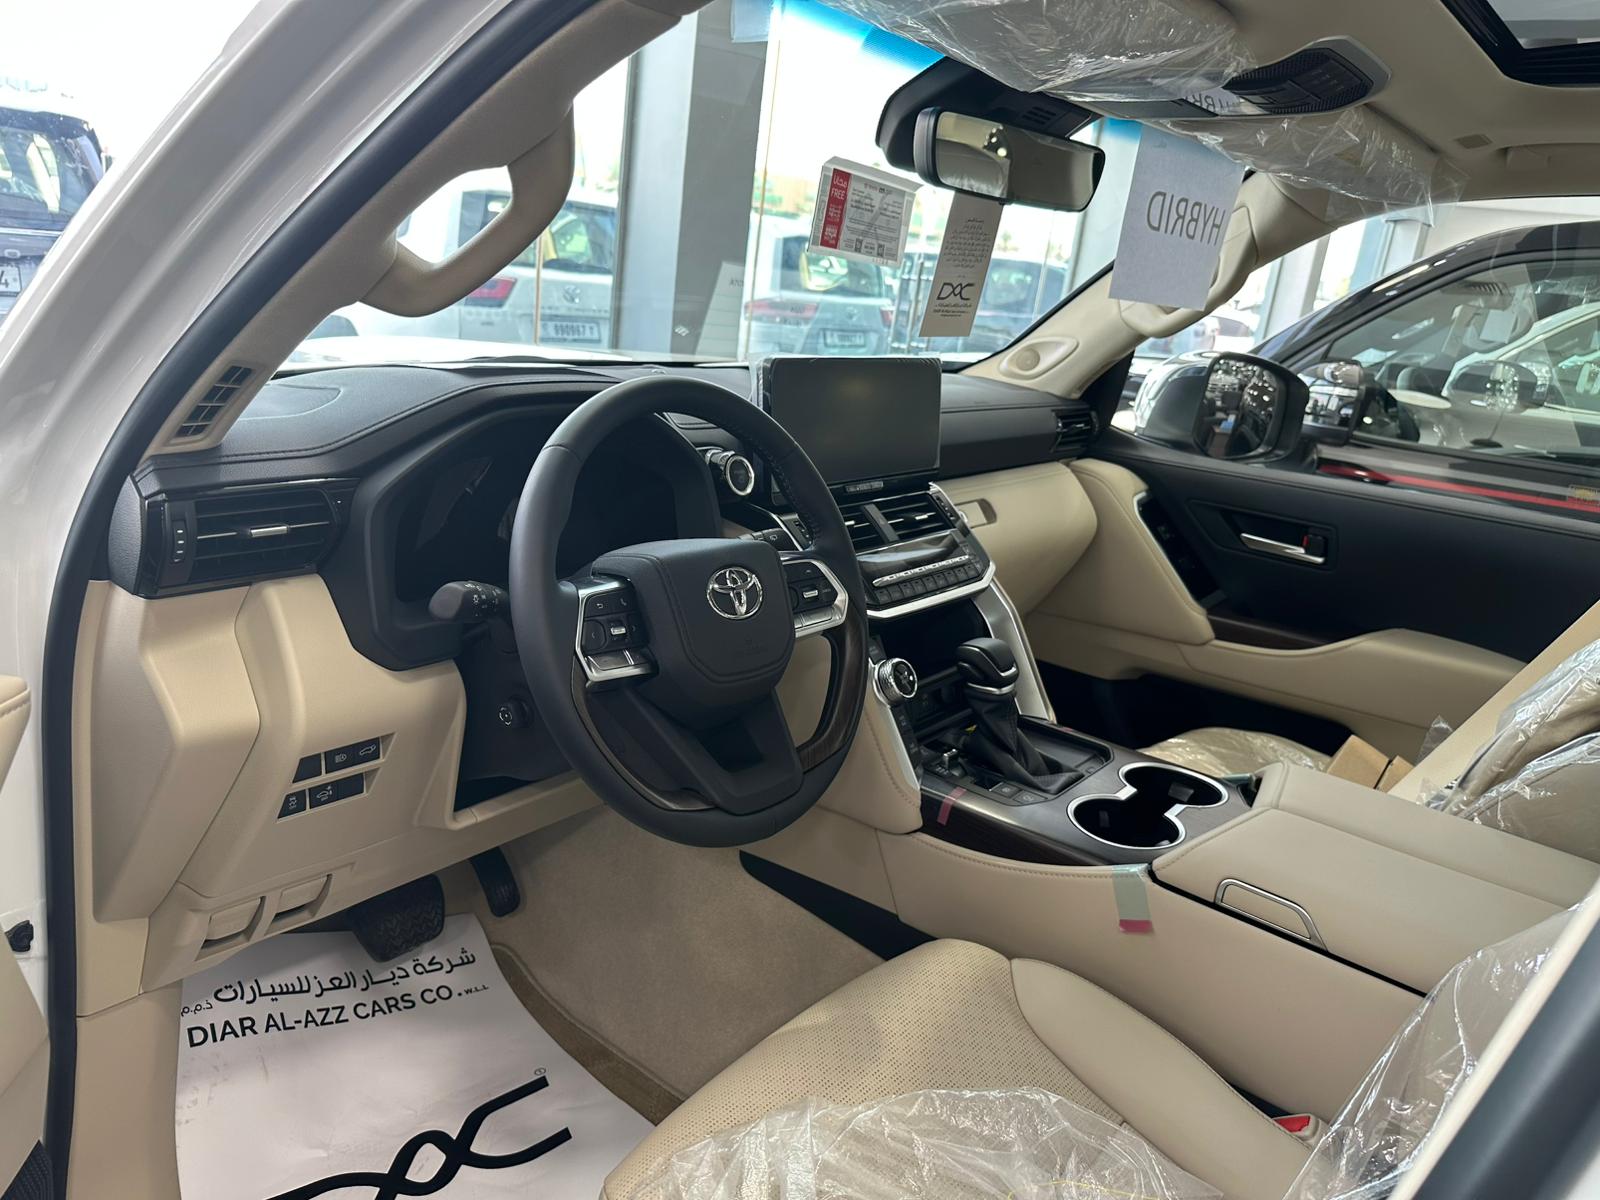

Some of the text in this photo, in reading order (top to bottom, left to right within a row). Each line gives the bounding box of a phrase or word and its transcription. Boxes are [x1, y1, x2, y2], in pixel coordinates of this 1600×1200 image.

[831, 188, 846, 200] FREE
[413, 947, 476, 975] شركة
[213, 975, 311, 1004] للسيارات
[313, 970, 357, 997] العز
[360, 964, 410, 991] ديار
[187, 1016, 258, 1048] DIAR
[264, 1005, 349, 1033] AL-AZZ
[353, 993, 416, 1019] CARS
